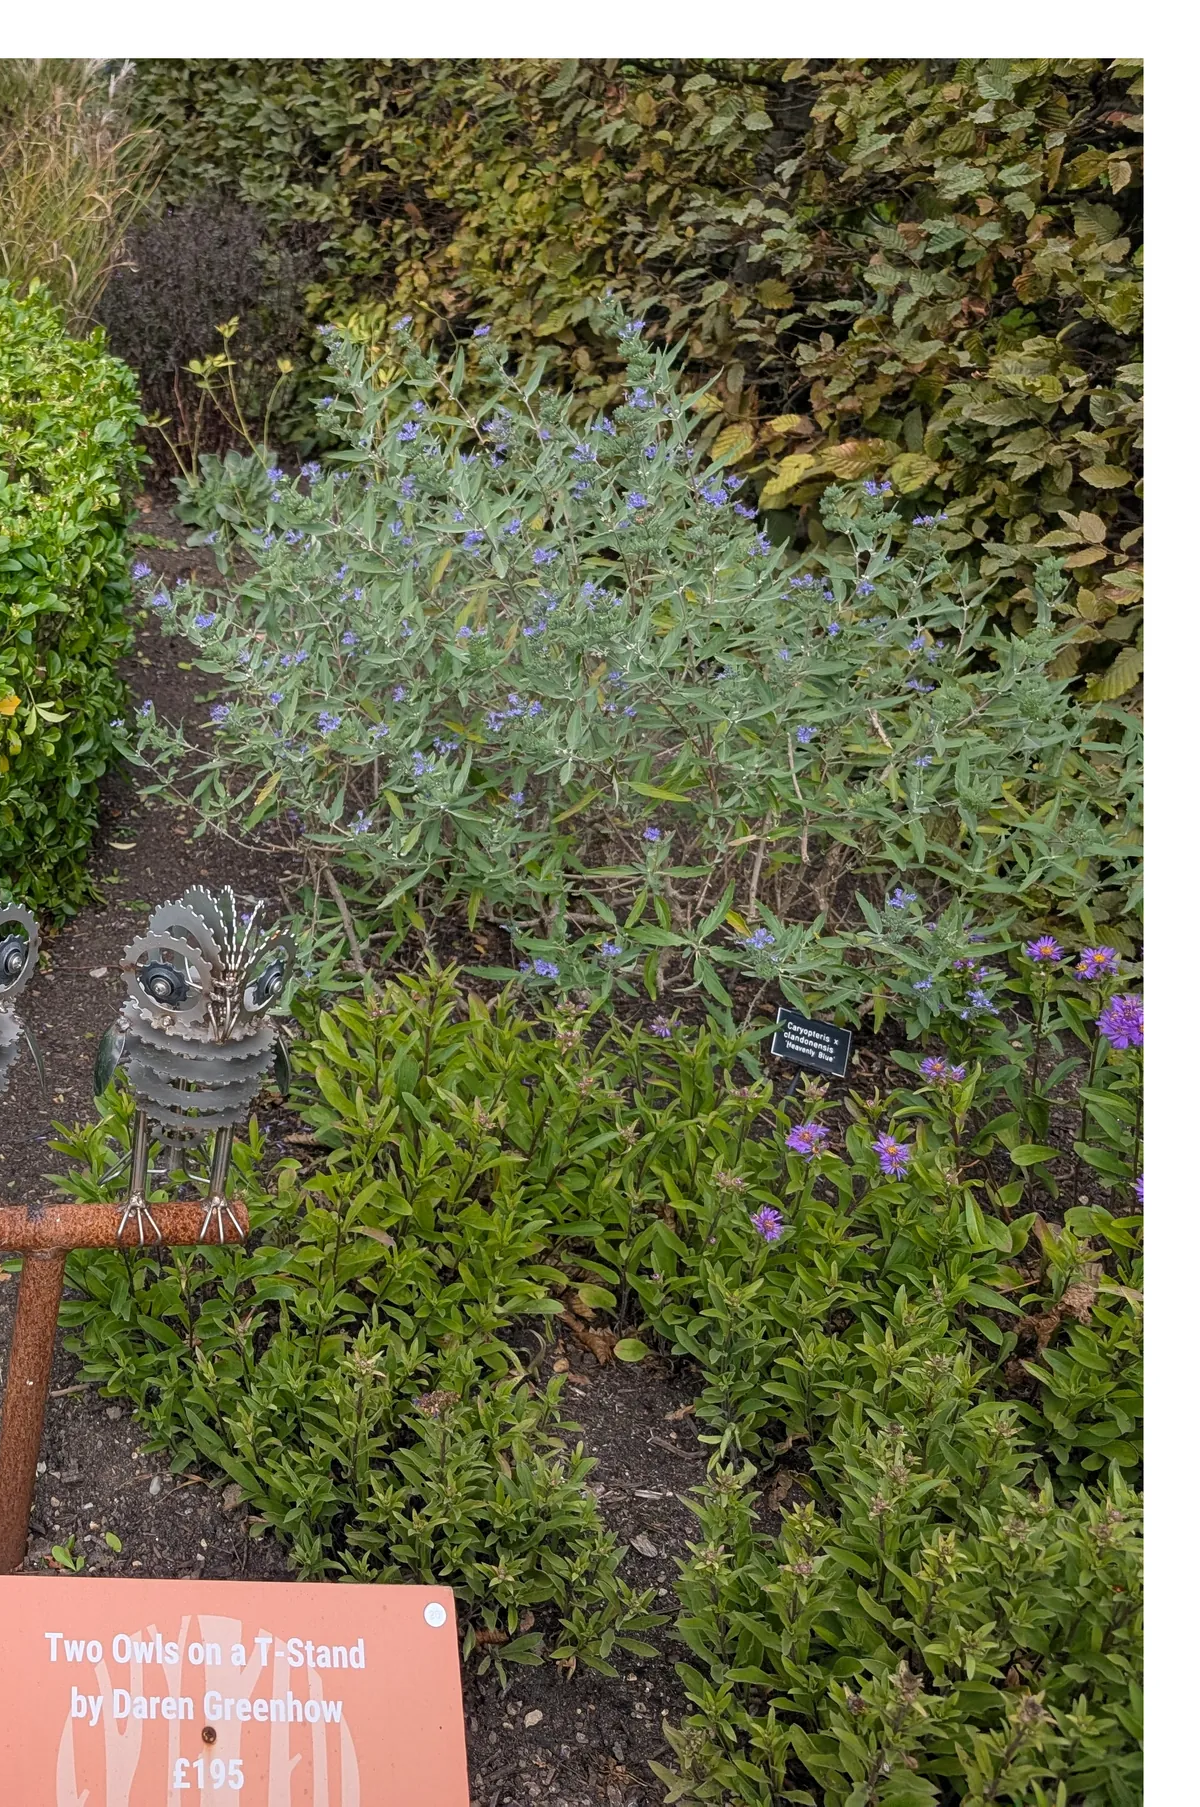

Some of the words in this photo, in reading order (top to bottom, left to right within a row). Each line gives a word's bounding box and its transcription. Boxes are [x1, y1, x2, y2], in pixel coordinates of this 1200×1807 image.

[784, 1032, 834, 1054] clandonensis
[787, 1021, 830, 1043] Caryopteris
[45, 1632, 103, 1663] Two
[112, 1633, 179, 1665] Owls
[189, 1641, 221, 1666] on
[231, 1643, 246, 1666] a
[254, 1637, 366, 1669] T-Stand
[71, 1687, 104, 1727] by
[113, 1689, 193, 1721] Daren
[203, 1691, 343, 1723] Greenhow
[173, 1758, 244, 1789] £195
